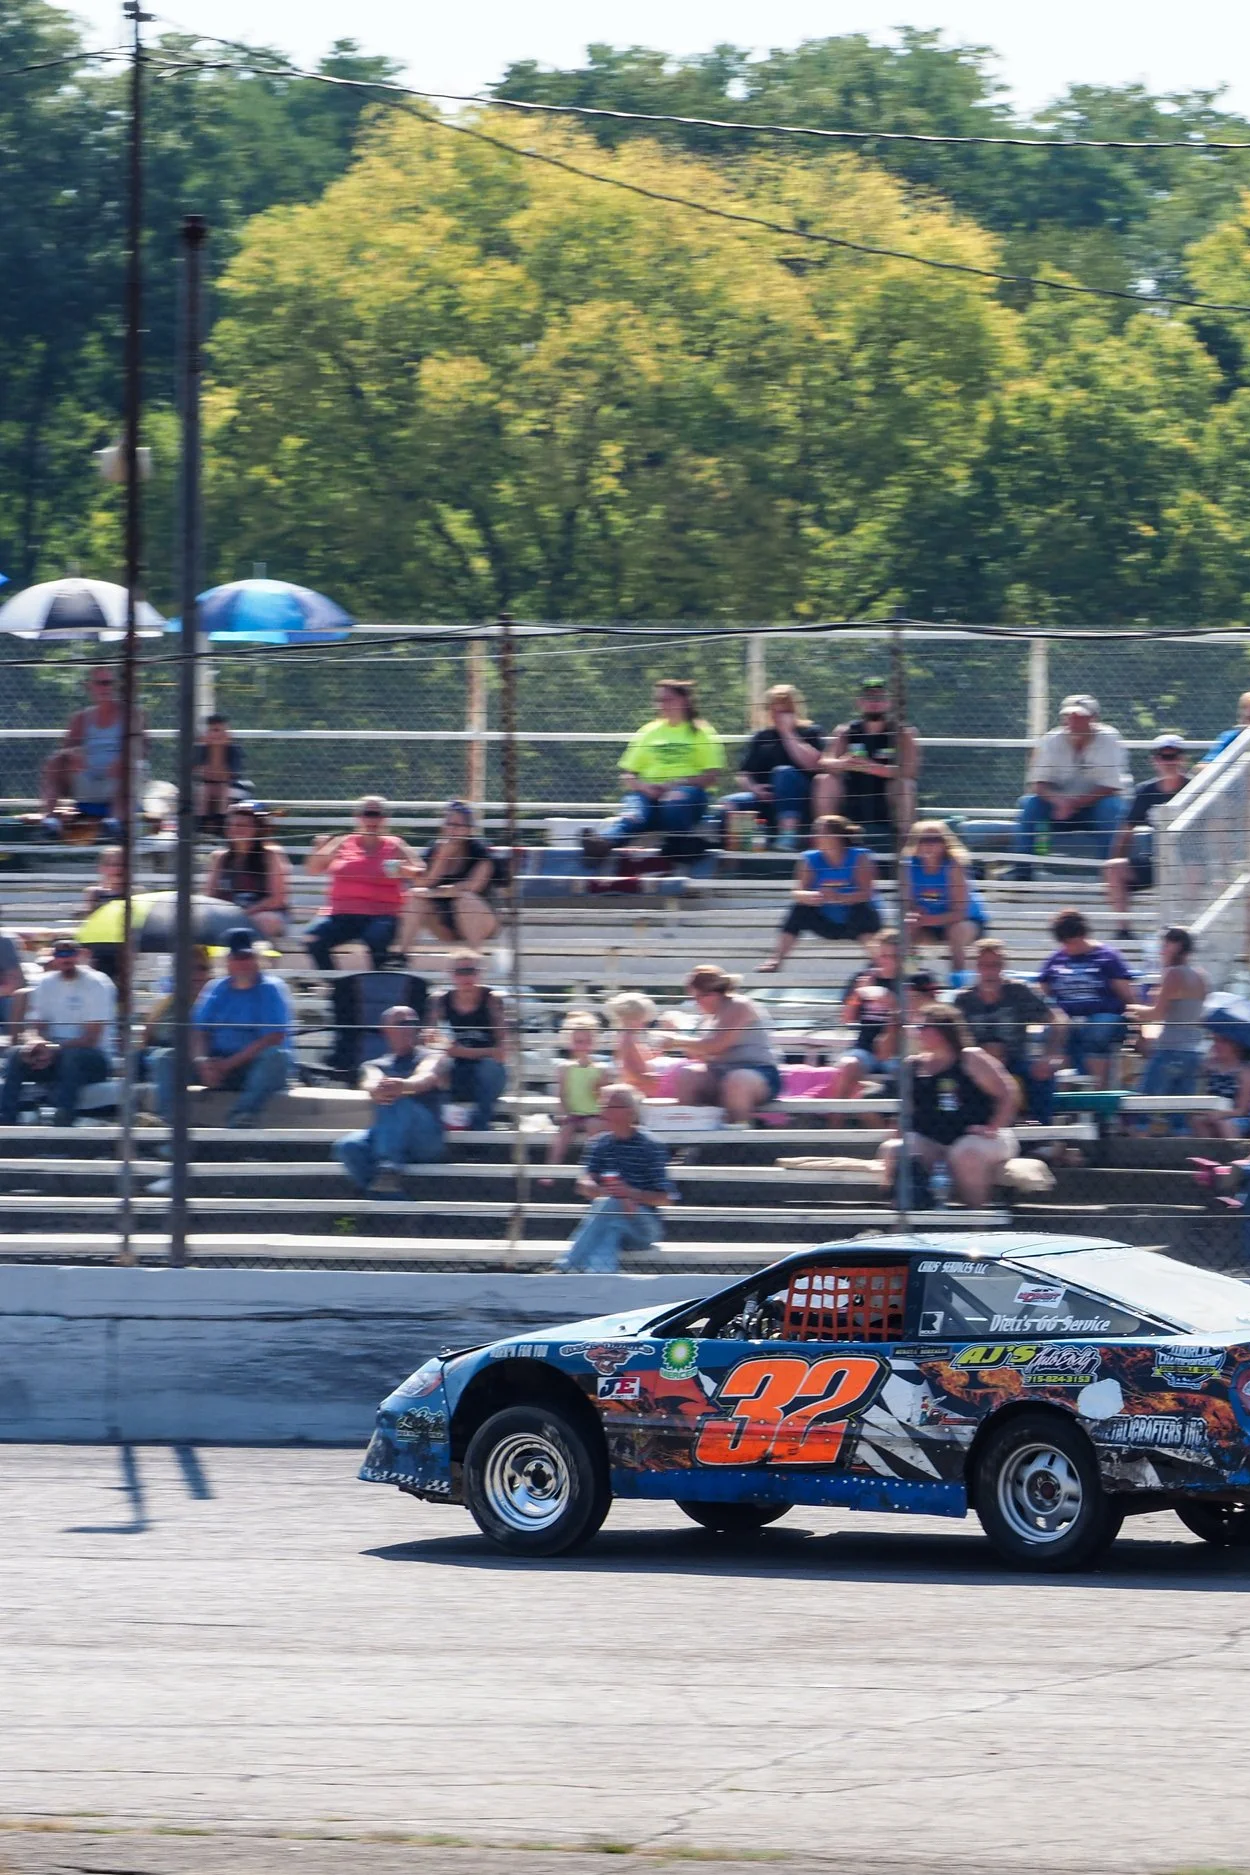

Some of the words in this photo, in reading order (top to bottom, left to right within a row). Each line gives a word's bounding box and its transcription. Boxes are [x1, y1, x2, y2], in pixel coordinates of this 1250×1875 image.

[1060, 1315, 1111, 1332] Service
[1158, 1352, 1223, 1366] CHAMPIONSHIP
[695, 1357, 881, 1466] 32
